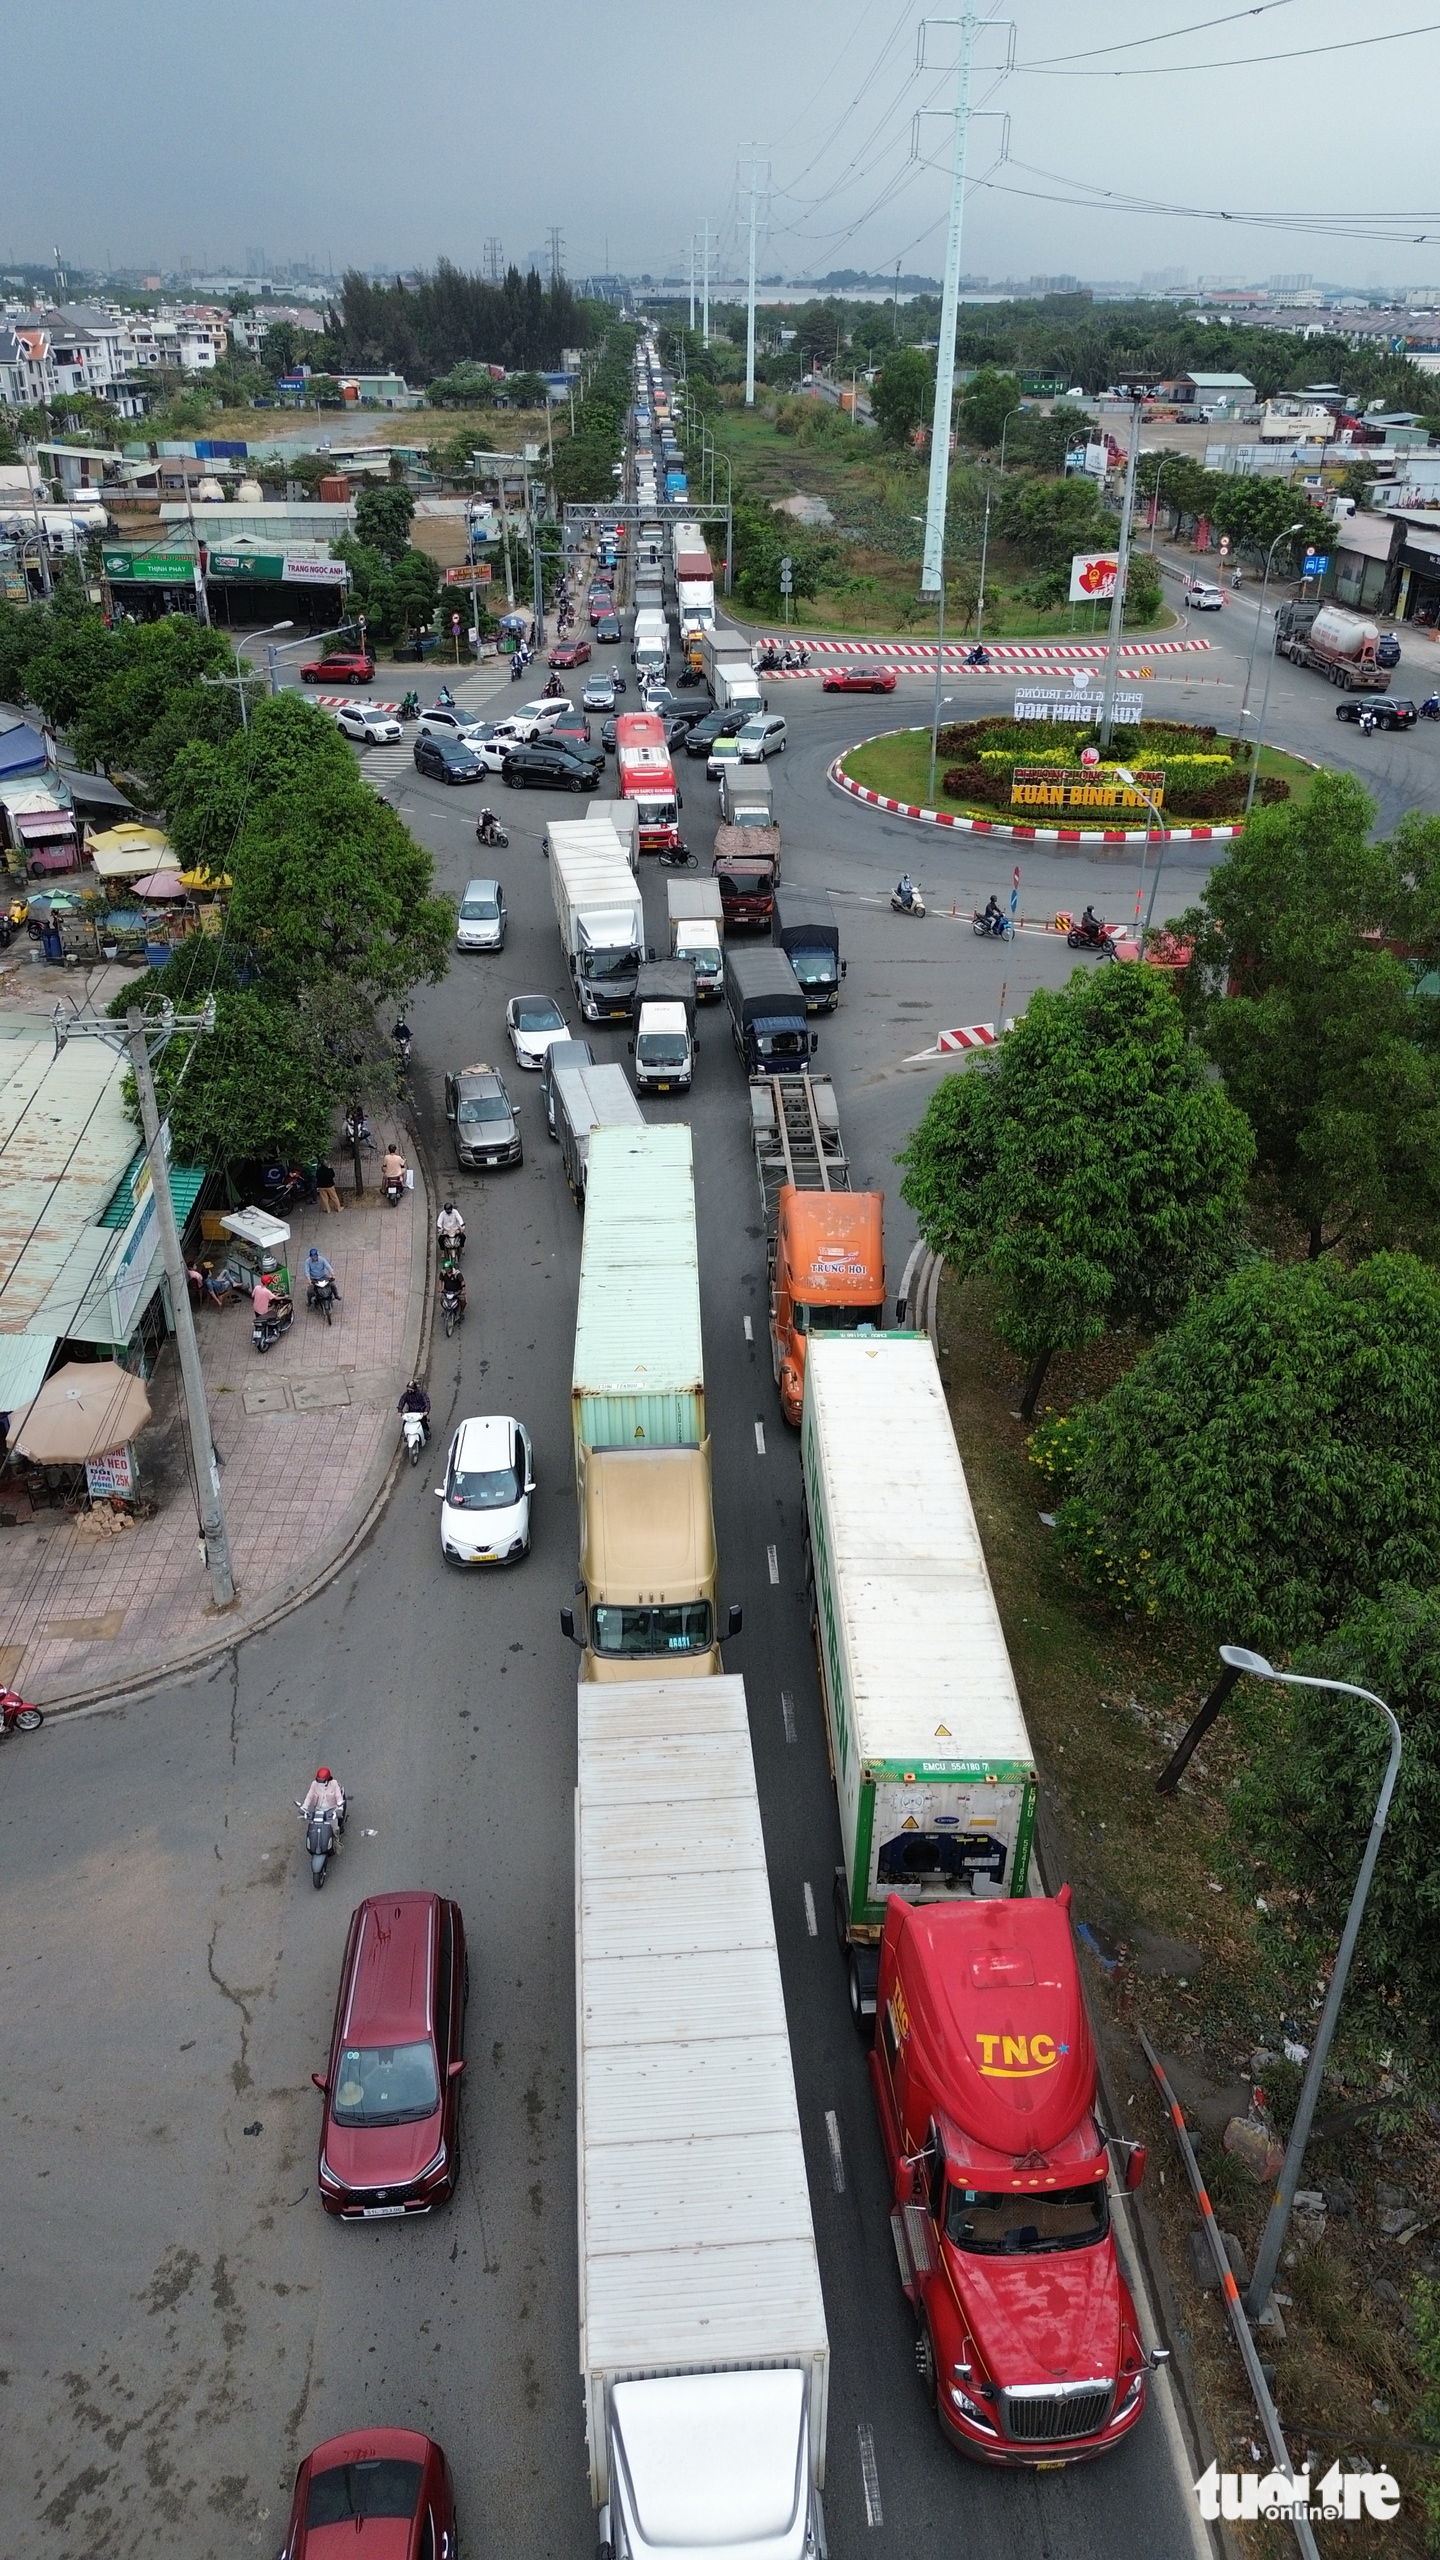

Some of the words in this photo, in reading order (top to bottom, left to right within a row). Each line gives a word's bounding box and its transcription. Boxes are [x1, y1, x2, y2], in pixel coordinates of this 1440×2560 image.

[287, 564, 309, 573] TRANG
[309, 565, 328, 575] NGỌC
[329, 567, 343, 575] ANH
[1012, 781, 1064, 805] XUÂN
[1070, 782, 1117, 806] BÍNH
[811, 1263, 845, 1274] TRUNG
[107, 1458, 128, 1470] HEO
[115, 1474, 131, 1487] 25K
[922, 1762, 946, 1772] EMCU
[950, 1762, 981, 1771] 554180
[982, 1762, 990, 1772] 7
[1027, 1787, 1037, 1818] EMCU
[1018, 1840, 1029, 1883] 554180
[1016, 1884, 1024, 1893] 7
[976, 2034, 1056, 2065] TNC
